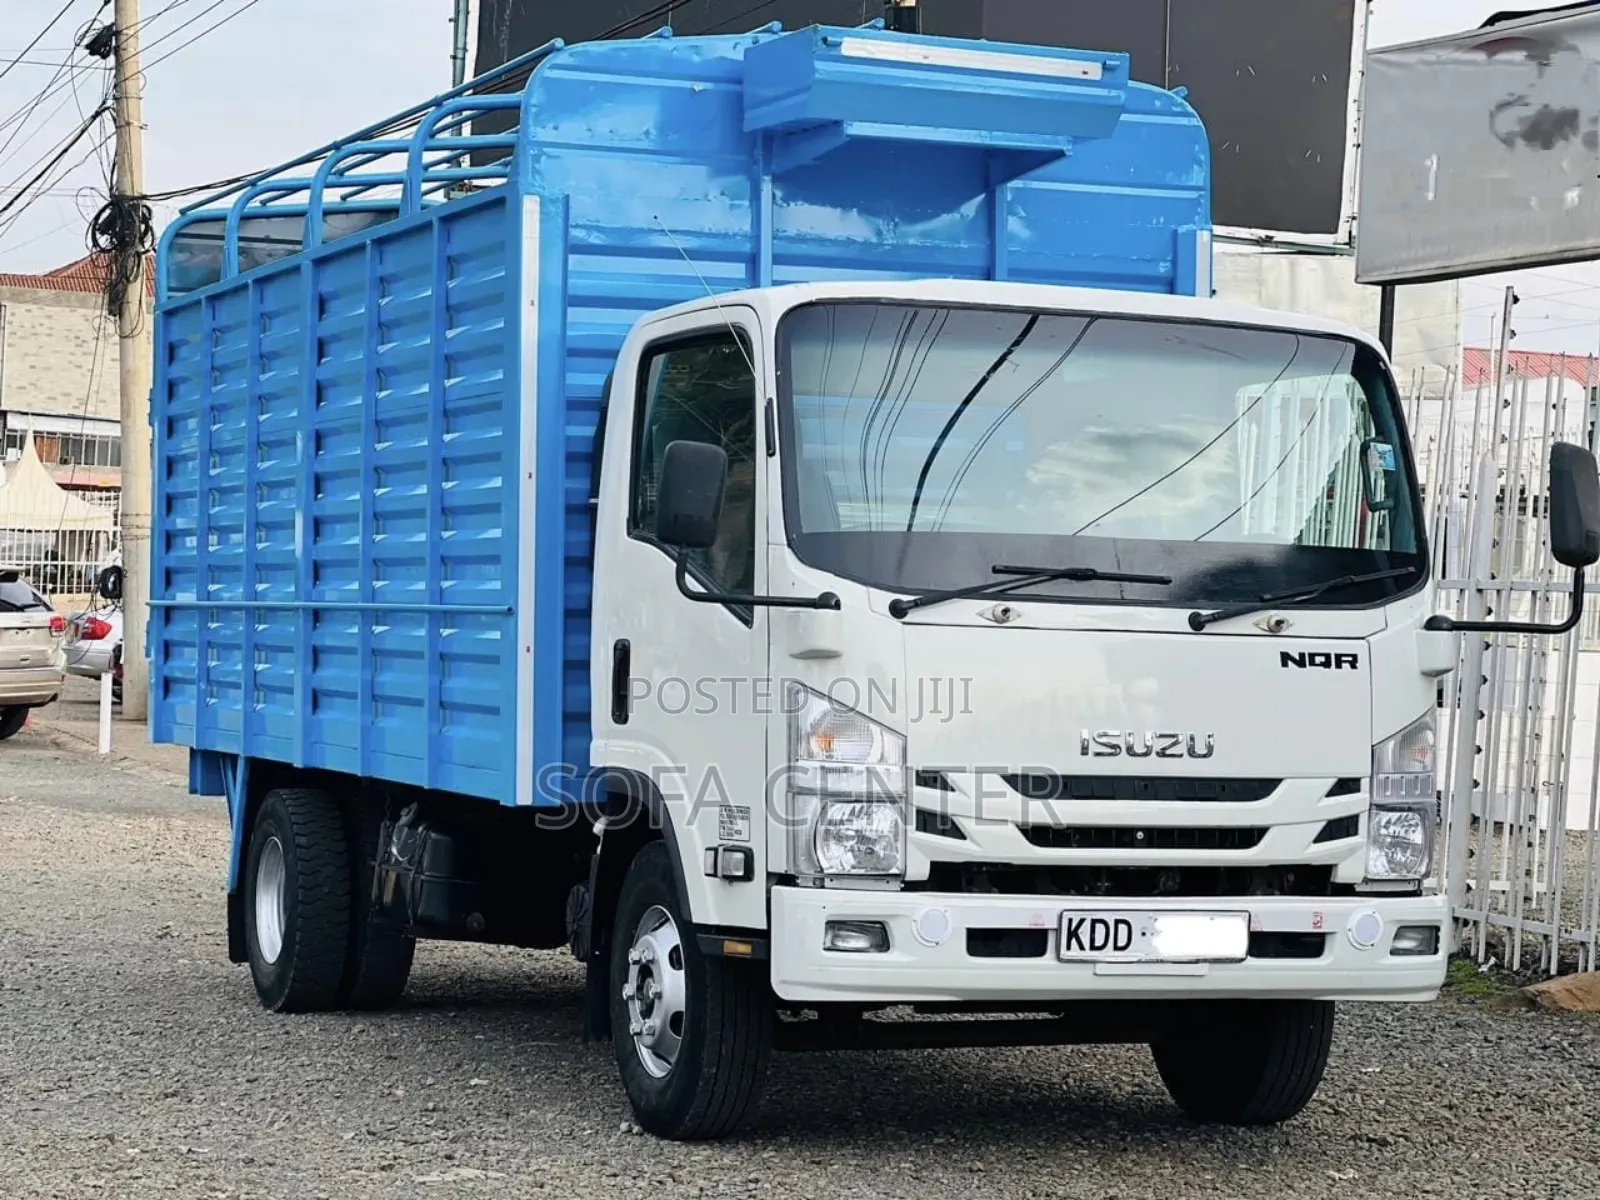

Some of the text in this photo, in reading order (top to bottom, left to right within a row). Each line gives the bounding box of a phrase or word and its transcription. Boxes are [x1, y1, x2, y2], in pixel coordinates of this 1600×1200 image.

[1279, 651, 1359, 669] NQR
[1080, 729, 1215, 759] ISUZU
[1065, 918, 1133, 951] KDD
